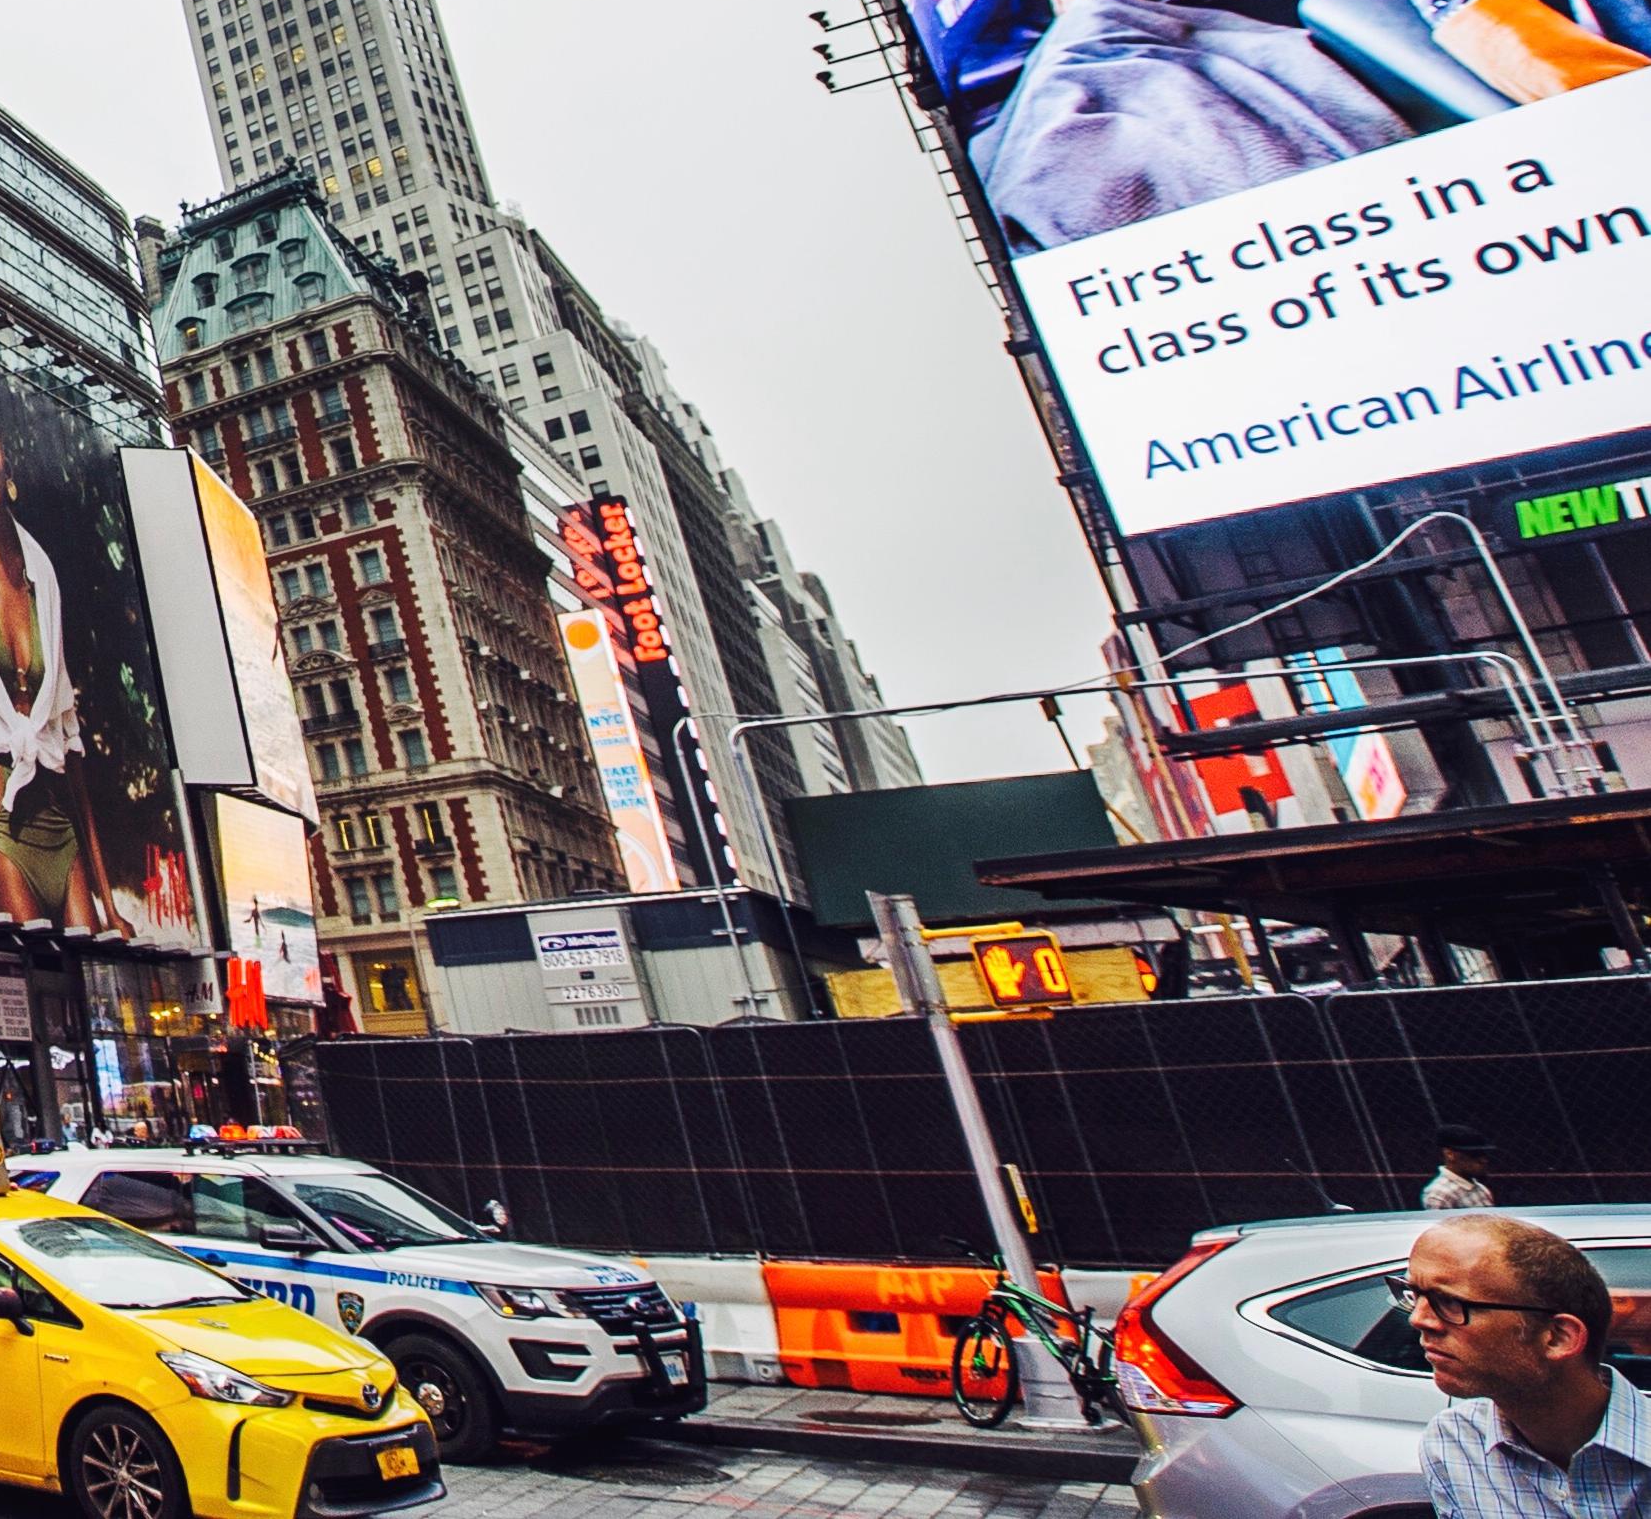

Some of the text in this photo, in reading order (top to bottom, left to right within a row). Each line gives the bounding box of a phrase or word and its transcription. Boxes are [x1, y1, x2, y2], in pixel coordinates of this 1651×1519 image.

[1069, 157, 1555, 316] First class in a
[1097, 201, 1650, 375] class of its own
[1144, 382, 1441, 481] American
[600, 503, 667, 662] Foot Locker
[390, 1272, 440, 1290] POLICE
